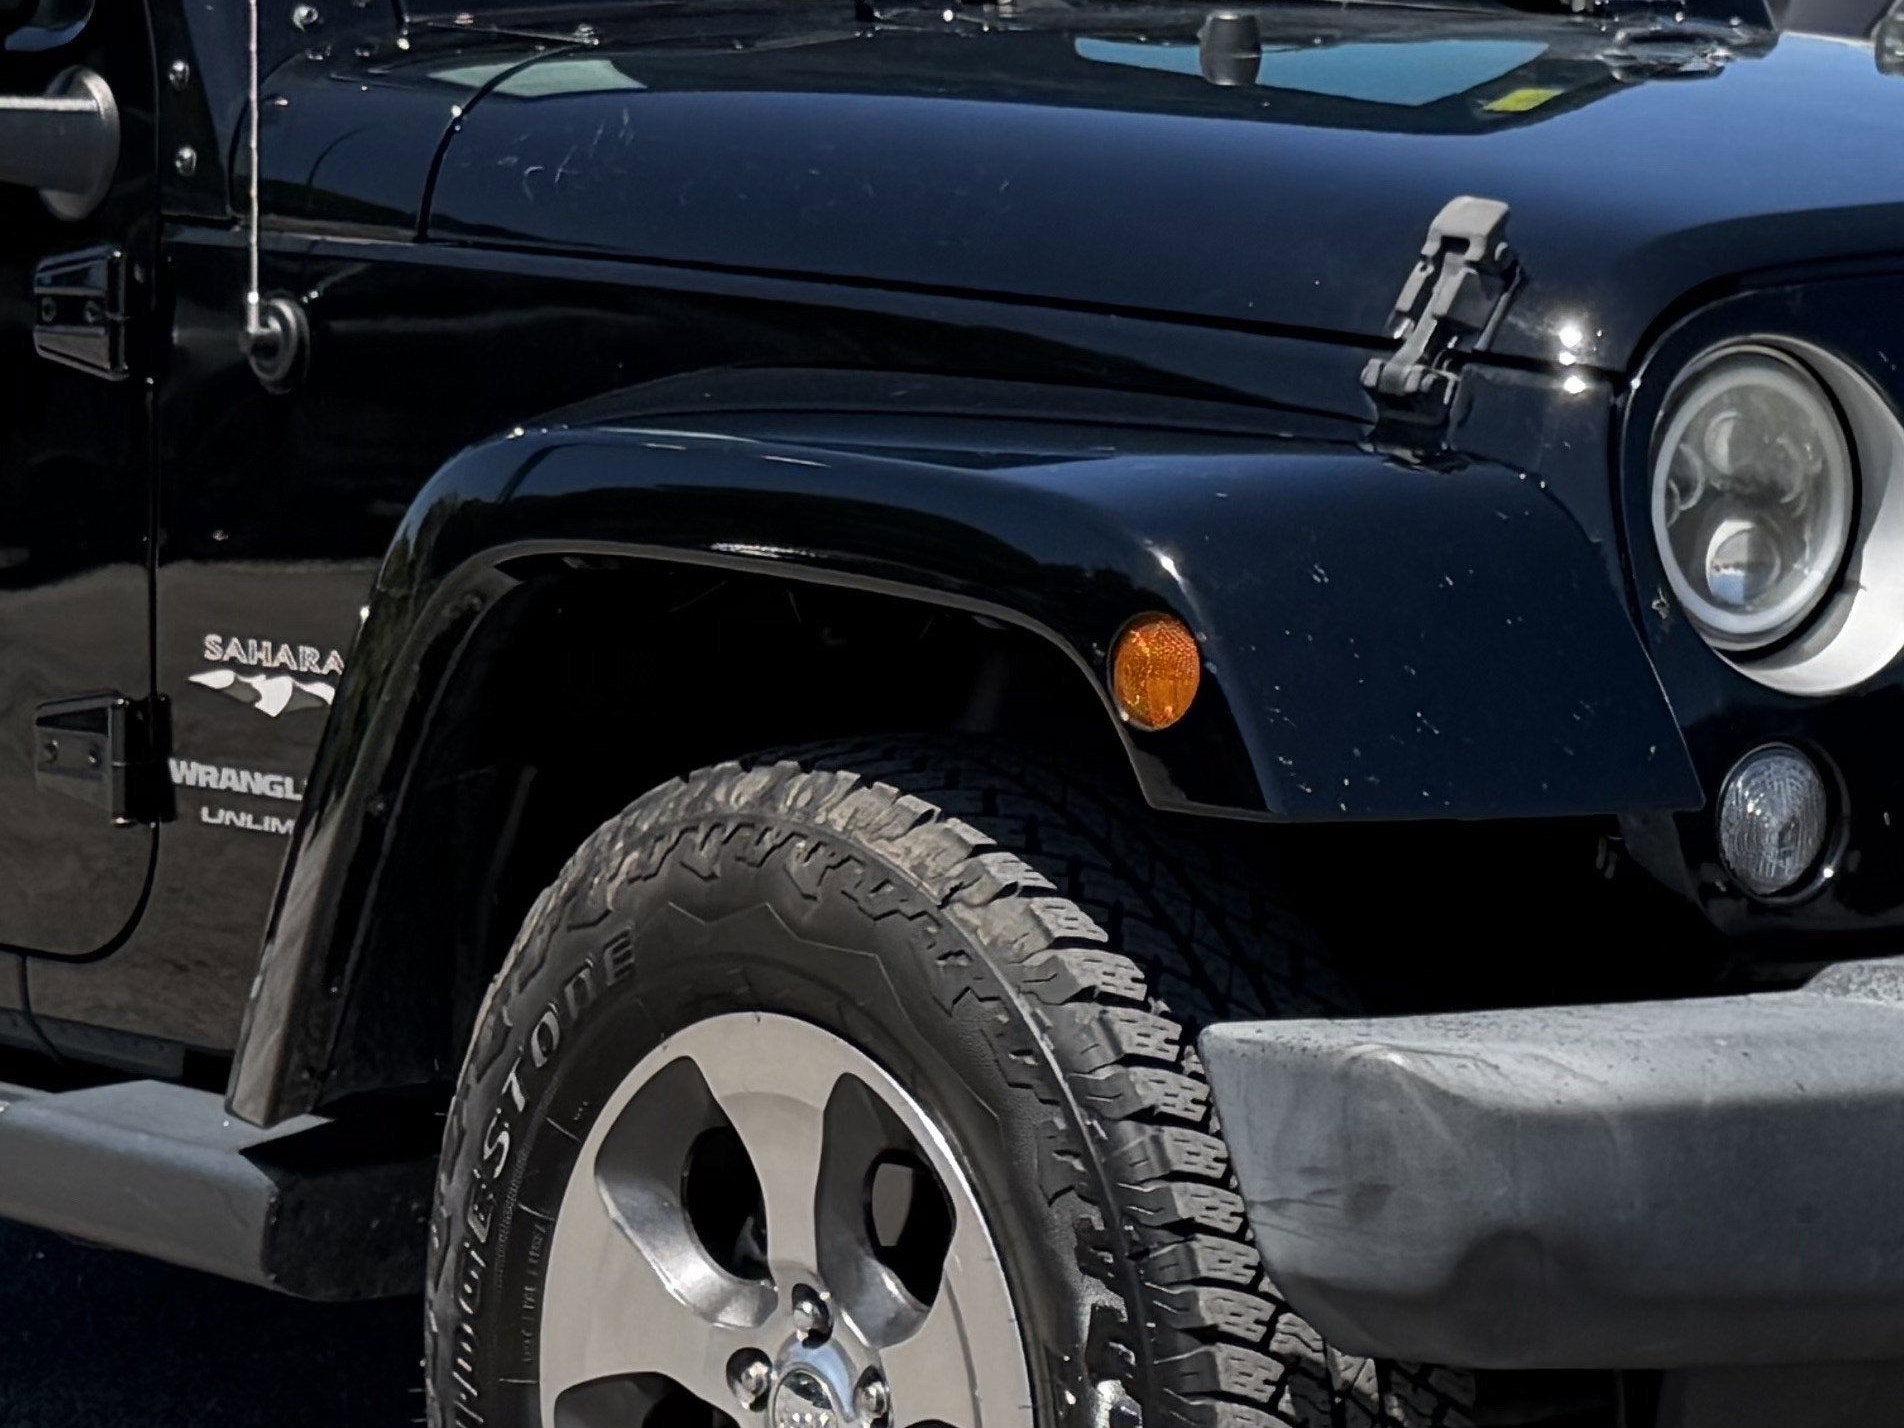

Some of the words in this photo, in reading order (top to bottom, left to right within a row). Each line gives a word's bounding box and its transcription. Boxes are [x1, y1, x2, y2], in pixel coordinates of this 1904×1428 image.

[203, 633, 346, 676] SAHARA
[168, 757, 307, 801] WRANGL
[201, 806, 296, 835] UNLIM
